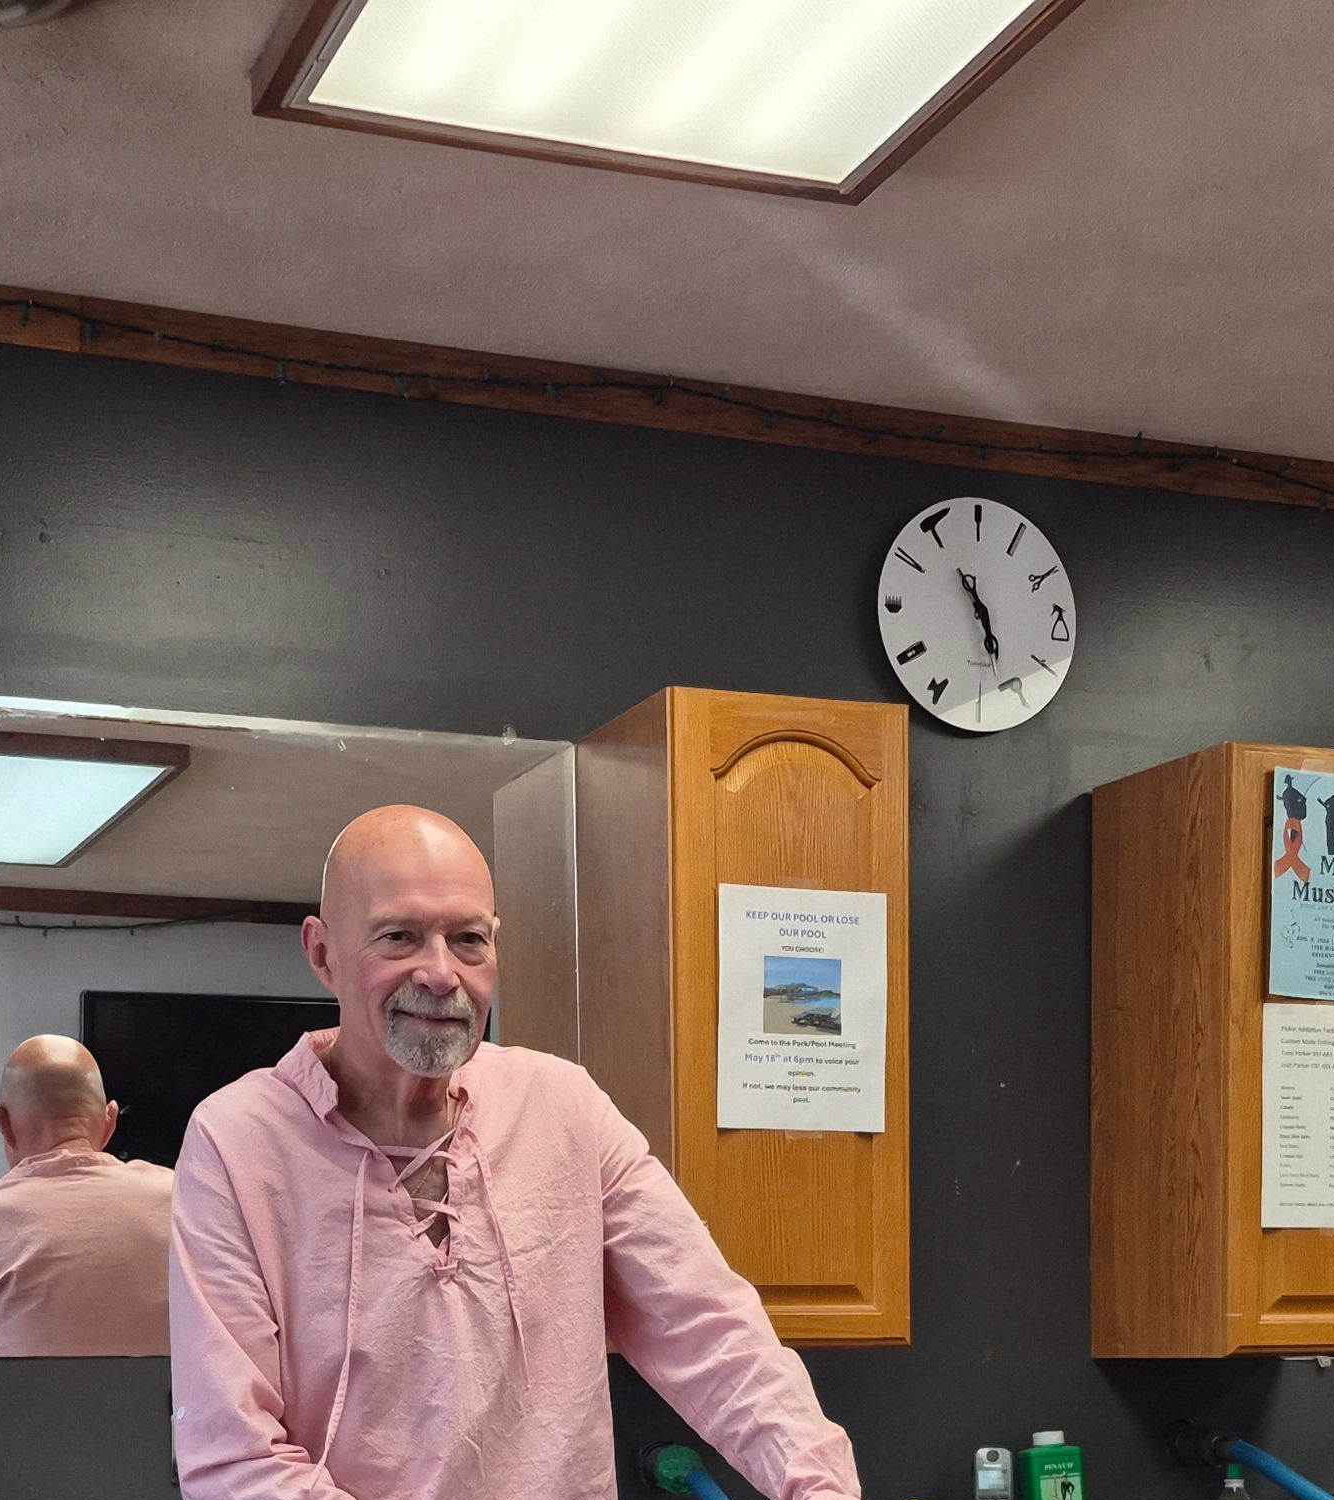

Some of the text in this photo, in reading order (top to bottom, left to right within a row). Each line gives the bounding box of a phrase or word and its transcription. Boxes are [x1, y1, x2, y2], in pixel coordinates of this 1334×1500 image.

[745, 910, 860, 926] KEEP OUR POOL OR LOSE
[779, 927, 827, 939] OUR POOL
[748, 1038, 856, 1050] Come to the Park/Pool Meeting
[744, 1053, 764, 1064] May
[783, 1055, 792, 1064] at
[793, 1054, 814, 1066] 6pm
[824, 1057, 843, 1066] voice
[844, 1059, 860, 1067] your
[787, 1069, 816, 1079] opinion.
[748, 1083, 763, 1091] not,
[776, 1085, 792, 1093] may
[792, 1084, 807, 1092] lose
[821, 1085, 861, 1094] community
[793, 1096, 811, 1104] pool.
